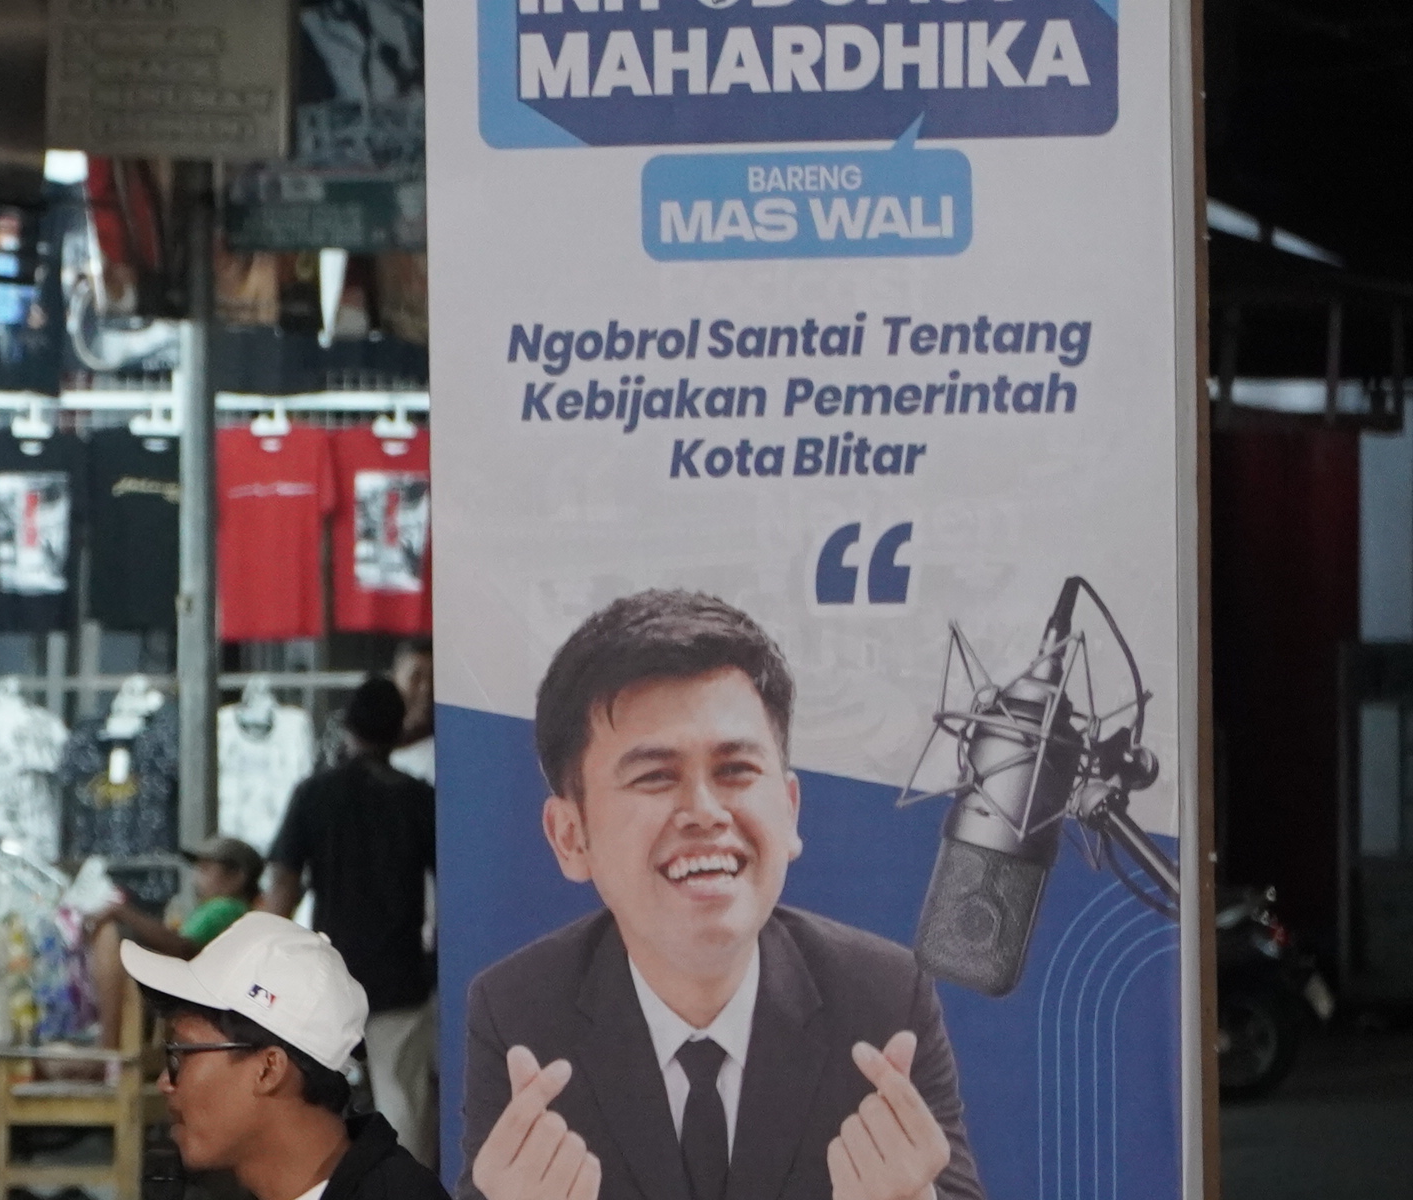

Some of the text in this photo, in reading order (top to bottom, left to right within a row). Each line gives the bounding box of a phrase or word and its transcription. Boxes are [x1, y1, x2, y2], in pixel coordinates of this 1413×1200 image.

[520, 20, 1090, 98] MAHARDHIKA
[749, 165, 862, 192] BARENG
[661, 196, 953, 243] MAS WALI
[508, 312, 1091, 375] Ngobrol Santai Tentang
[522, 370, 1077, 433] Kebijakan Pemerintah
[670, 431, 926, 478] Kota Blitar
